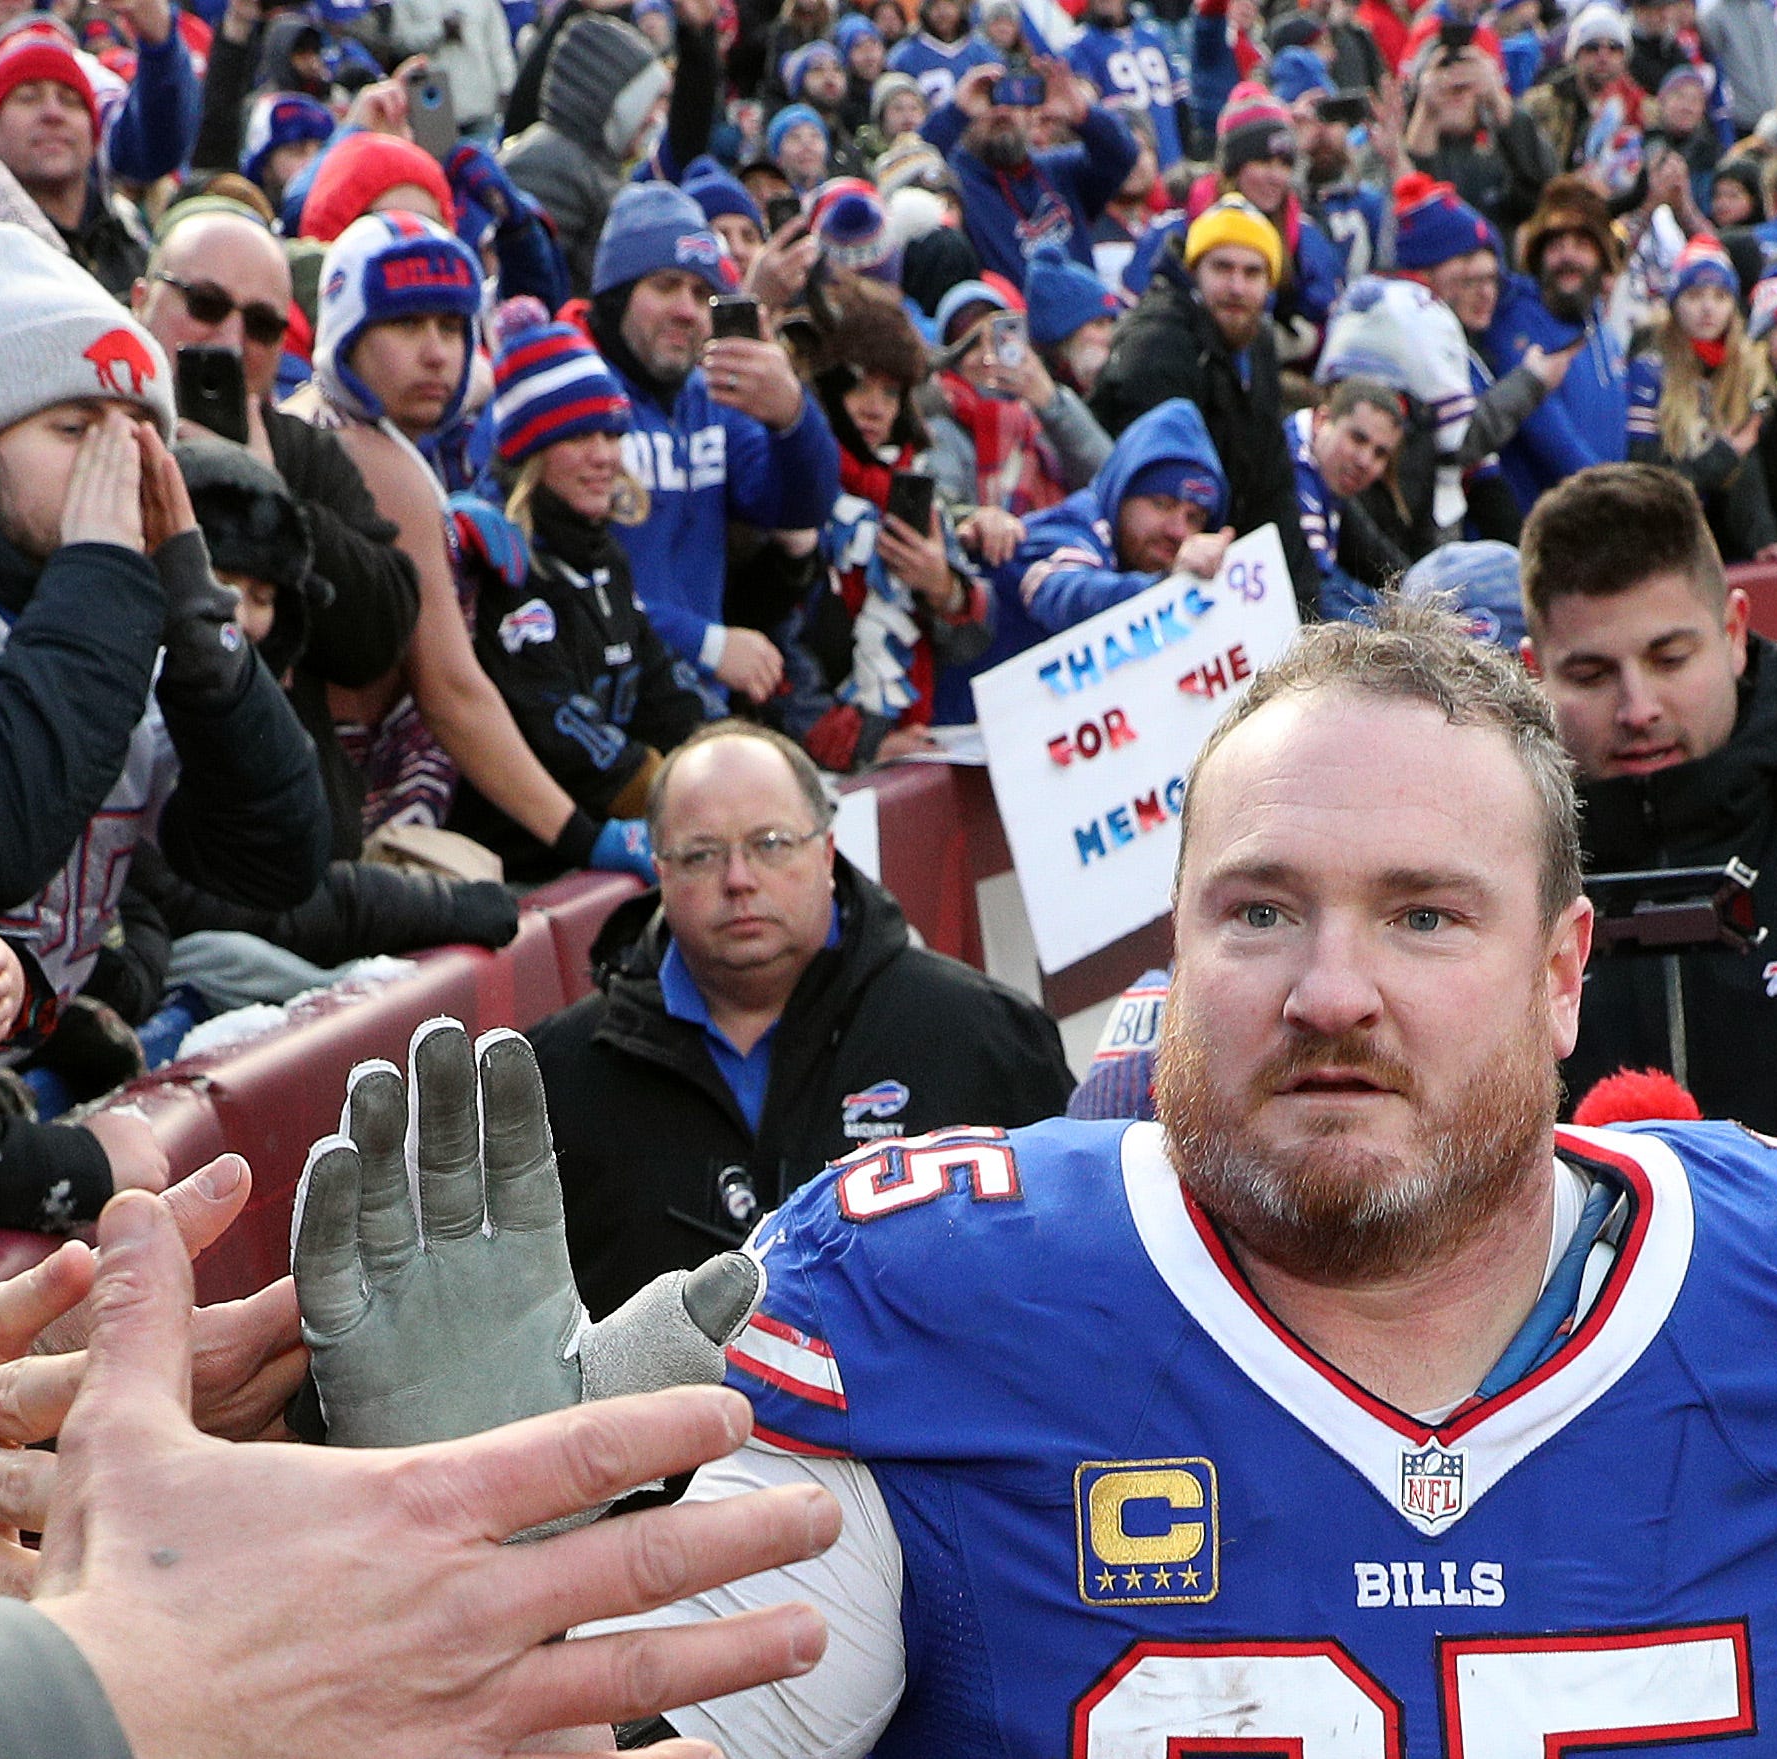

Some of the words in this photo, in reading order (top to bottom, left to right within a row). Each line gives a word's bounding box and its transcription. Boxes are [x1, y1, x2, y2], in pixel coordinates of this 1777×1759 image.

[1037, 585, 1216, 697] THANKS
[1227, 561, 1267, 604] 95
[1047, 707, 1137, 768] FOR
[1177, 643, 1253, 699] THE
[1088, 1468, 1206, 1566] C
[1406, 1475, 1458, 1516] NFL
[1353, 1561, 1506, 1608] BILLS
